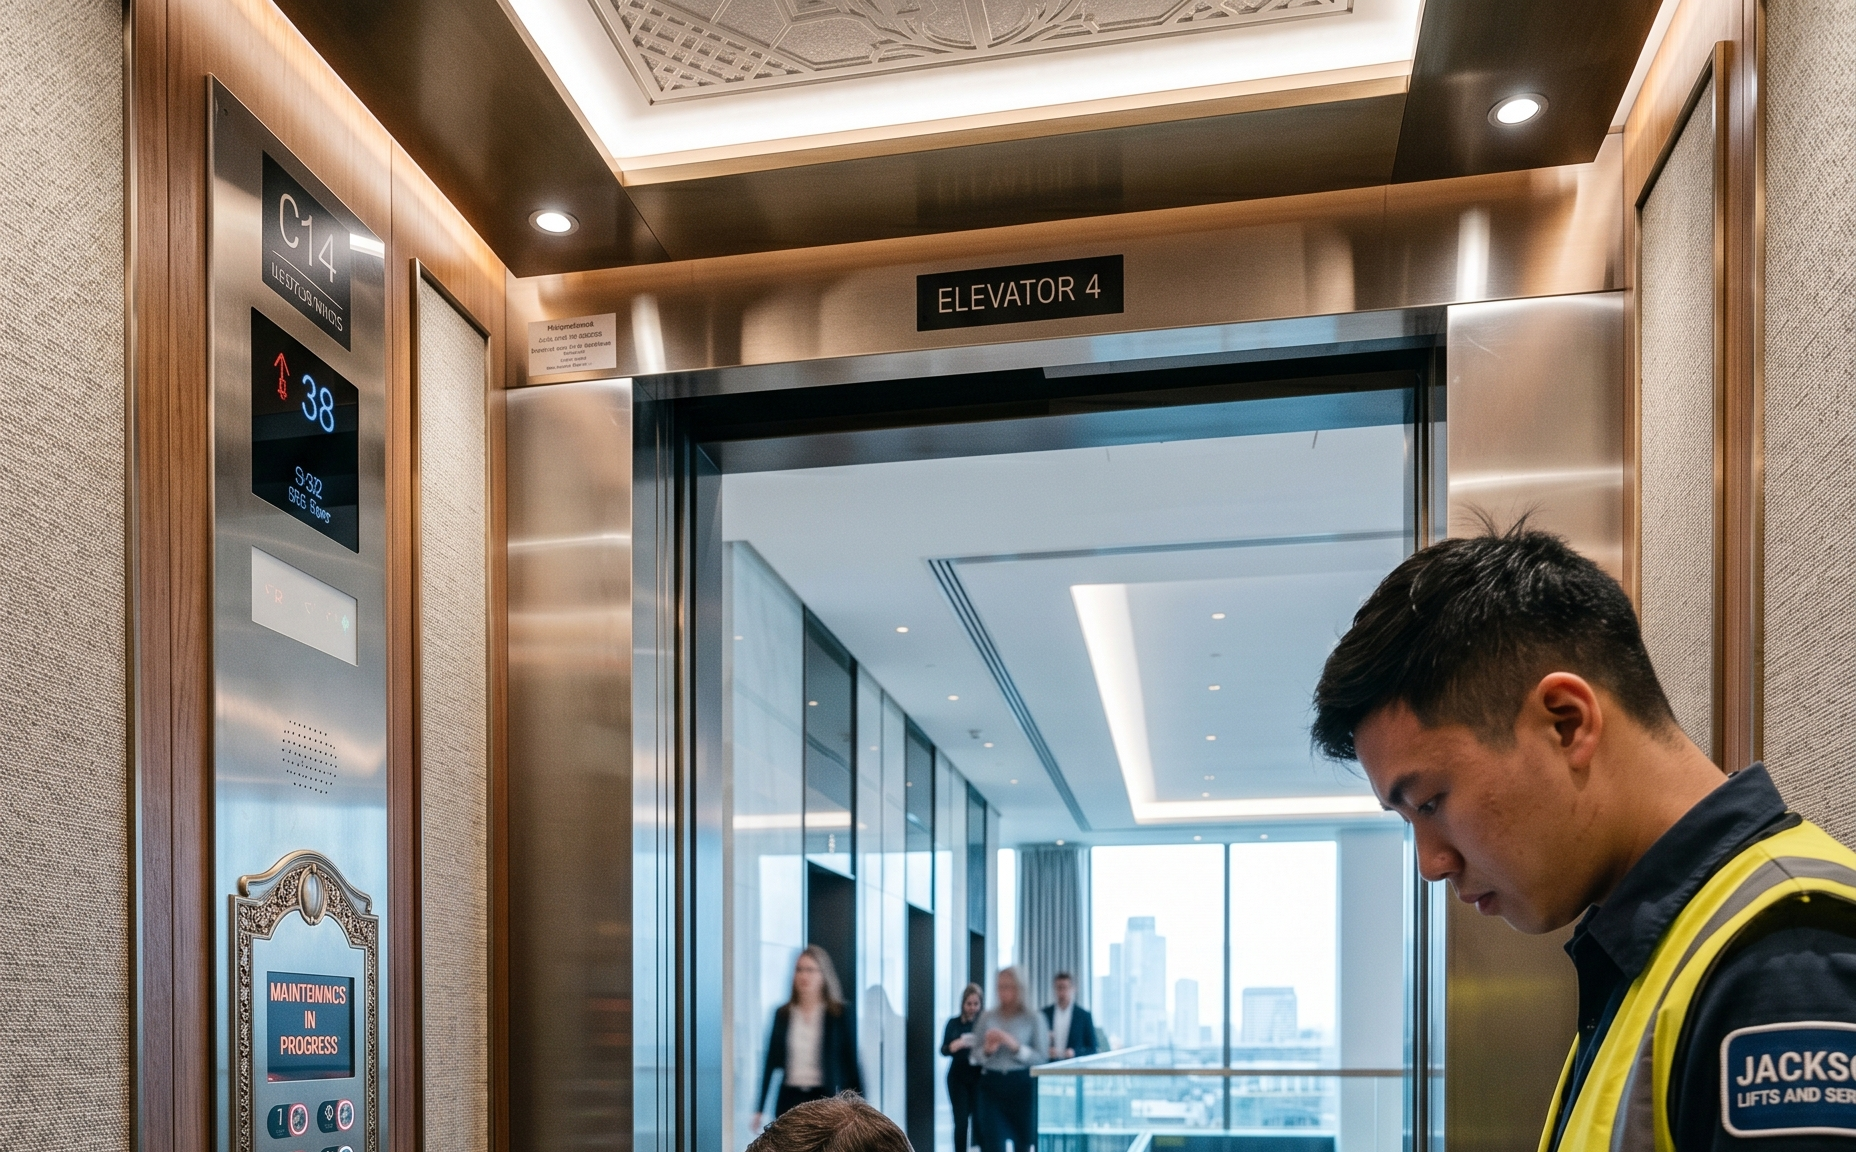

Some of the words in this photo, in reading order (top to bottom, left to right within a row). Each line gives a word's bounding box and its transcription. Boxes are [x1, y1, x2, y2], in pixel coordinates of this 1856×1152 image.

[280, 193, 337, 284] C14
[938, 276, 1076, 314] ELEVATOR
[1085, 273, 1102, 299] 4
[301, 374, 335, 433] 38
[304, 1010, 316, 1029] IN
[280, 1035, 338, 1055] PROGRESS
[1736, 1050, 1856, 1087] JACKS
[1737, 1088, 1781, 1108] LIFTS
[1783, 1087, 1822, 1103] AND
